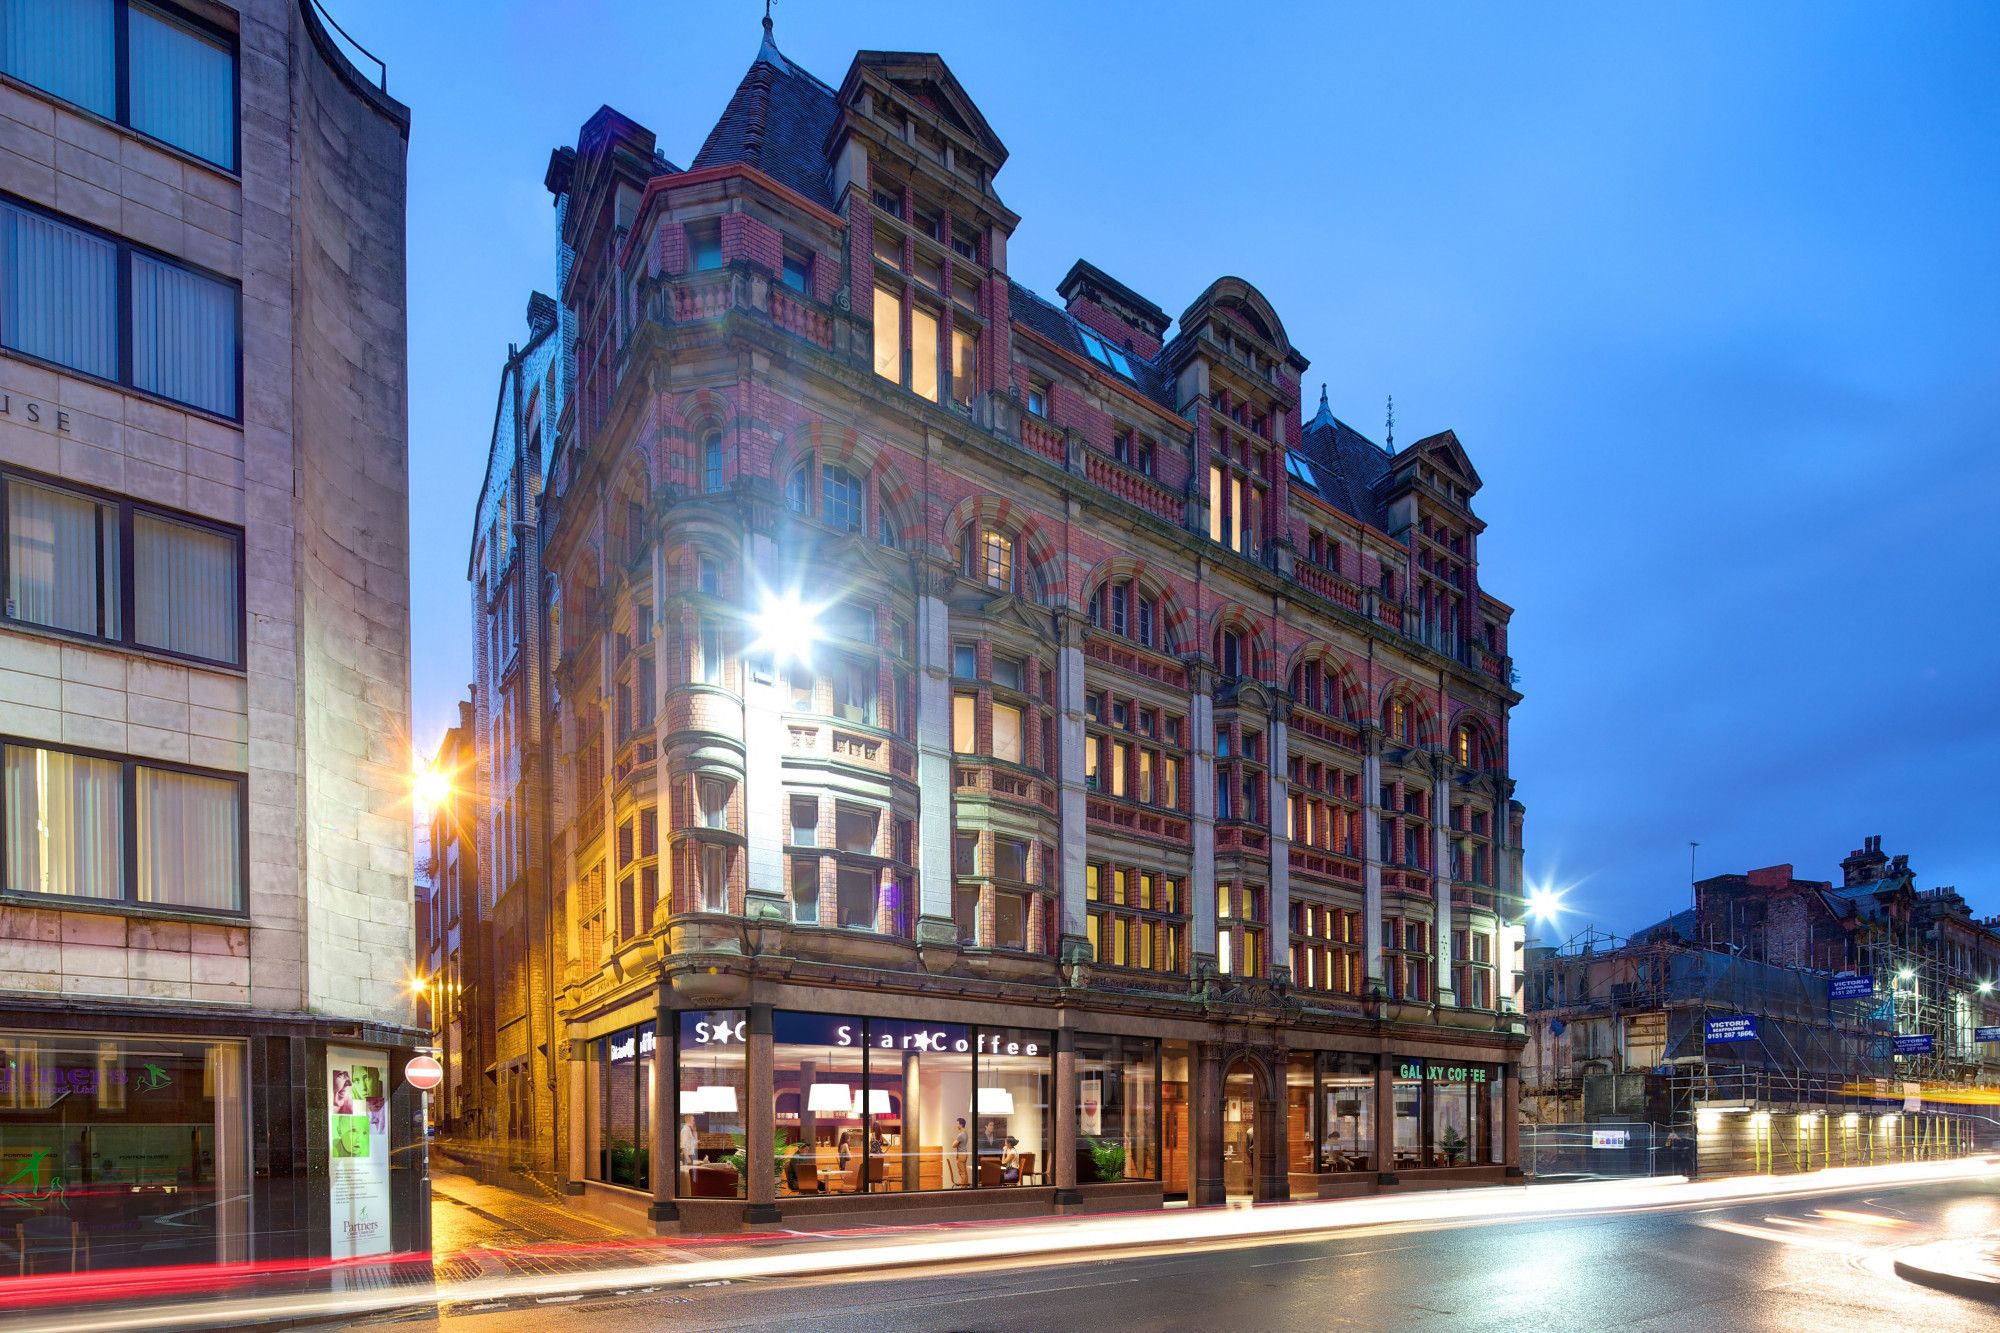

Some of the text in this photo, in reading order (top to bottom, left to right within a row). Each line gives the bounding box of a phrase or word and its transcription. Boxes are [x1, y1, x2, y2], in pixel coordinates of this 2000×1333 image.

[1833, 979, 1870, 987] VICTORIA
[1710, 1019, 1751, 1028] VICTORIA
[1707, 1032, 1723, 1040] 0151
[1447, 1067, 1486, 1083] COFEE
[343, 1219, 379, 1233] Partners
